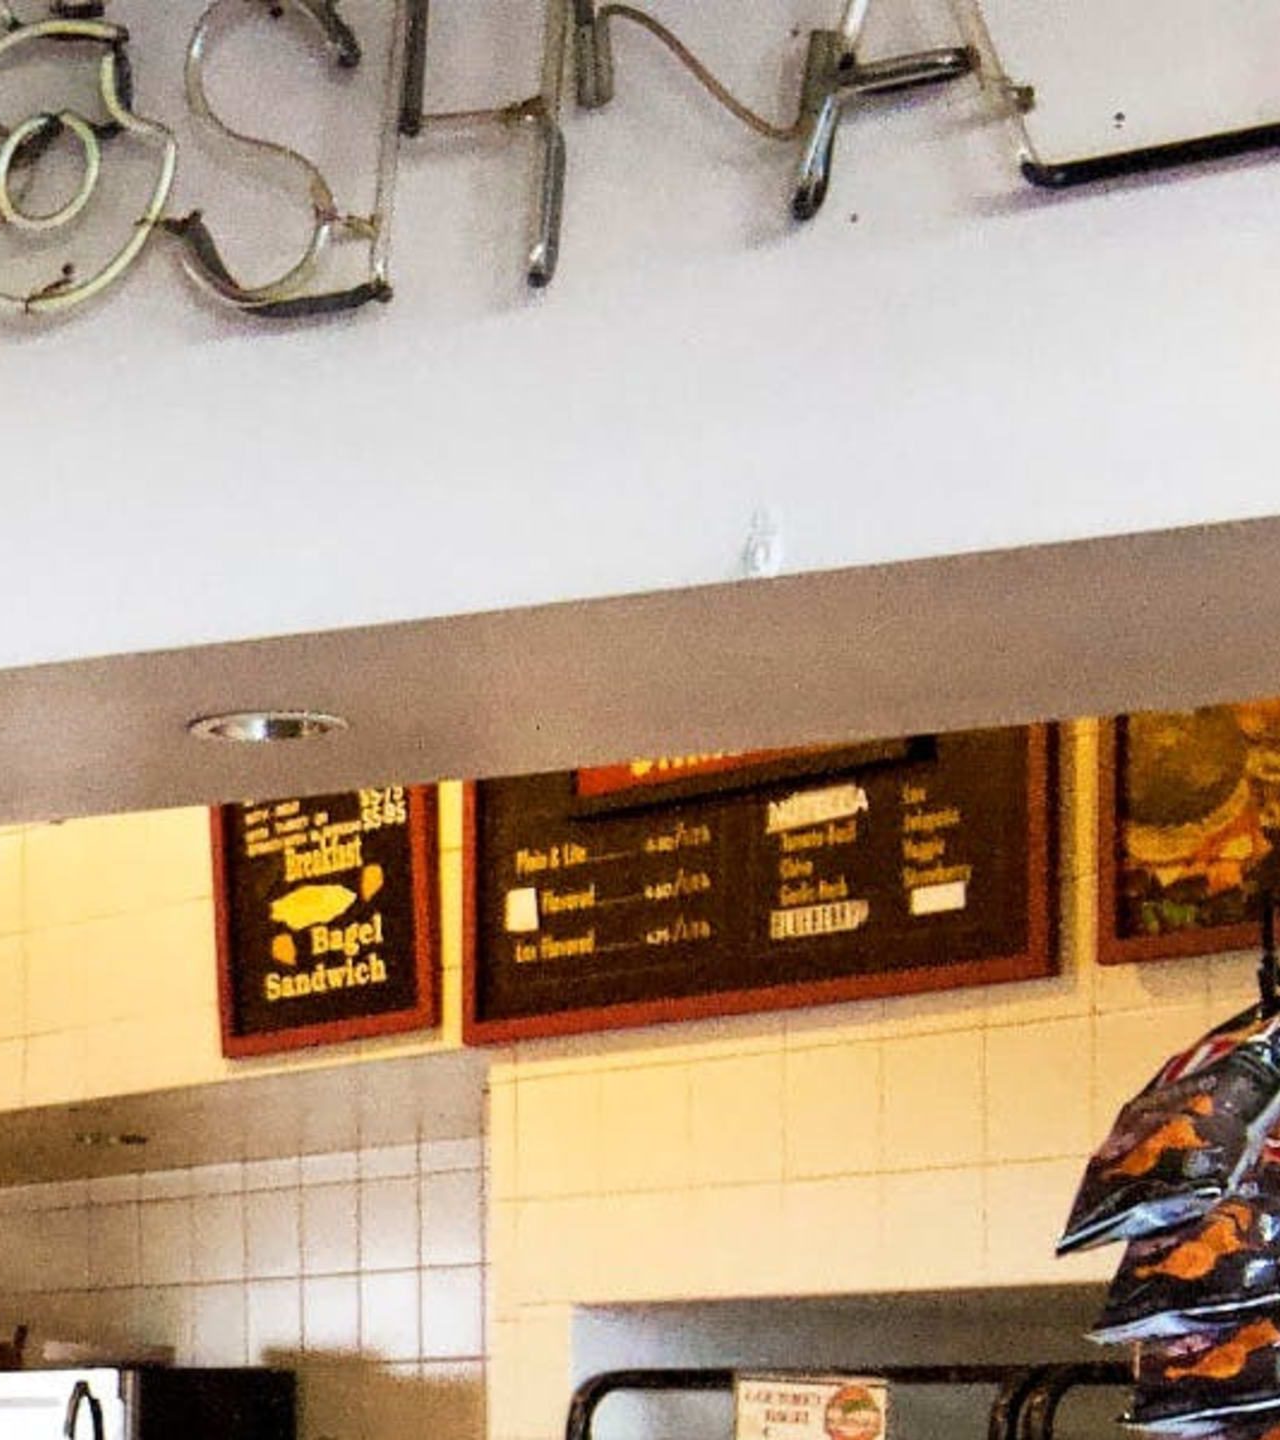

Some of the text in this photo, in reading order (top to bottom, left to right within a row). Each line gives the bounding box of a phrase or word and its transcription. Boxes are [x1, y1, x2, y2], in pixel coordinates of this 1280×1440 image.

[285, 835, 363, 882] Breakfast
[311, 913, 383, 956] Bagel
[265, 953, 387, 1001] Sandwich
